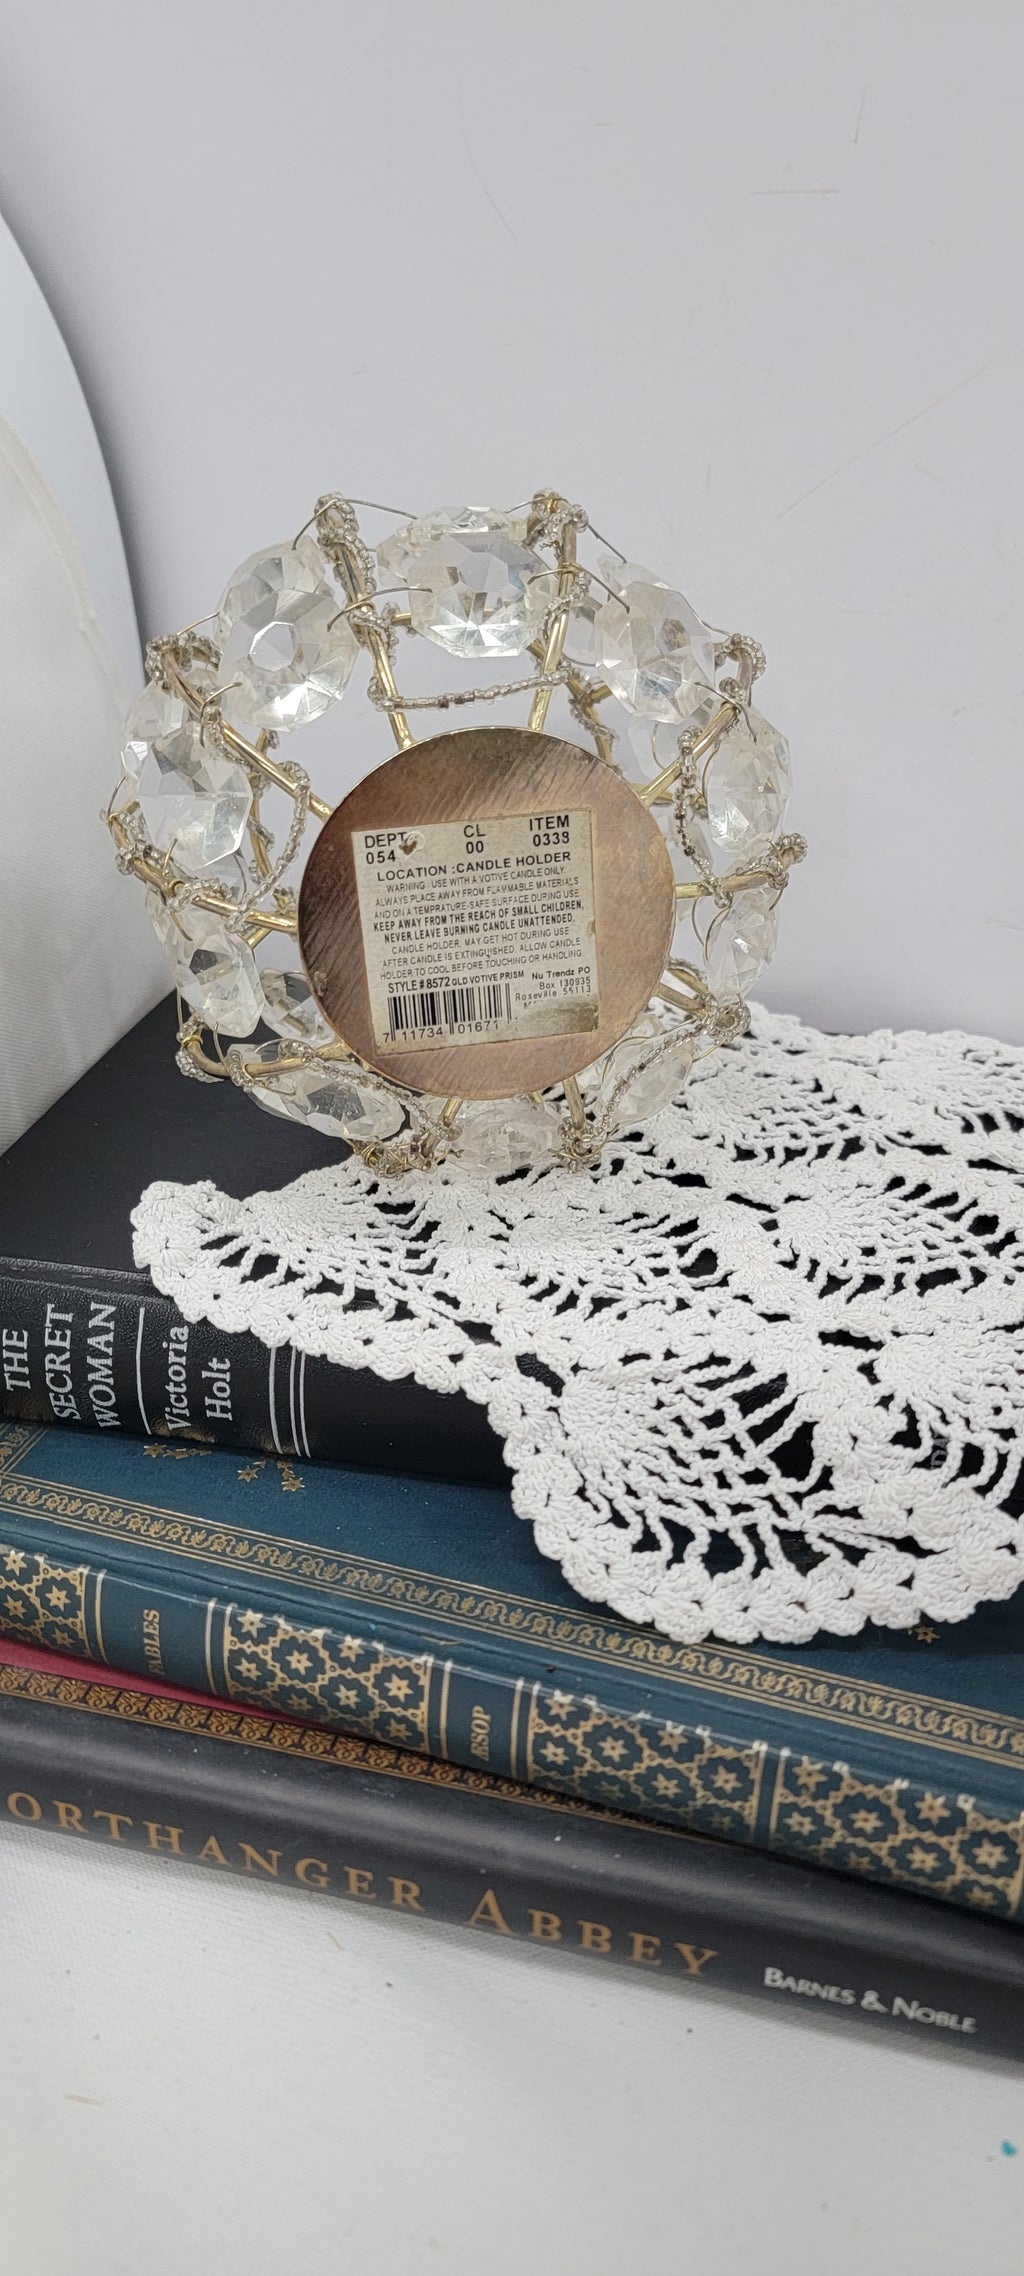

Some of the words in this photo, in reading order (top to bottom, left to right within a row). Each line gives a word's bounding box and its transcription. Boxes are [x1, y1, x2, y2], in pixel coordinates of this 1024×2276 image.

[463, 824, 486, 838] CL
[529, 815, 569, 831] ITEM
[366, 849, 396, 865] 054
[466, 841, 484, 854] 00
[377, 864, 447, 881] LOCATION
[516, 851, 571, 867] HOLDER
[375, 895, 408, 907] ALWAYS
[411, 892, 436, 903] PLACE
[438, 890, 461, 900] AWAY
[462, 887, 485, 897] FROM
[487, 881, 534, 895] FLAMMABLE
[536, 876, 579, 889] MATERIALS
[431, 879, 447, 888] USE
[449, 876, 470, 887] WITH
[472, 875, 477, 883] A
[479, 871, 508, 883] VOTIVE
[511, 868, 542, 880] CANDLE
[373, 920, 396, 932] KEEP
[399, 918, 422, 929] AWAY
[424, 915, 447, 926] FROM
[449, 913, 465, 923] THE
[468, 909, 496, 921] REACH
[498, 908, 509, 918] OF
[512, 904, 539, 917] SMALL
[374, 910, 391, 920] AND
[393, 909, 405, 918] ON
[407, 908, 412, 916] A
[492, 894, 529, 907] SURFACE
[531, 891, 562, 902] DURING
[563, 889, 580, 898] USE
[384, 931, 412, 943] NEVER
[415, 928, 441, 940] LEAVE
[443, 924, 480, 937] BURNING
[482, 920, 516, 932] CANDLE
[391, 943, 424, 955] CANDLE
[465, 937, 481, 946] MAY
[483, 935, 500, 945] GET
[501, 932, 518, 942] HOT
[520, 929, 551, 941] DURING
[553, 926, 569, 936] USE
[380, 969, 412, 980] HOLDER
[415, 967, 426, 976] TO
[427, 965, 450, 975] COOL
[451, 960, 483, 973] BEFORE
[485, 956, 527, 968] TOUCHING
[529, 954, 540, 963] OR
[542, 949, 582, 961] HANDLING
[382, 958, 408, 967] AFTER
[410, 953, 442, 965] CANDLE
[444, 952, 453, 961] IS
[519, 942, 547, 952] ALLOW
[549, 937, 581, 949] CANDLE
[388, 980, 417, 994] STYLE
[451, 977, 468, 986] GLD
[469, 972, 498, 984] VOTIVE
[500, 970, 525, 981] PRISM
[532, 972, 544, 980] Nu
[546, 968, 575, 978] Trendz
[578, 966, 591, 974] PO
[539, 981, 555, 990] Box
[515, 989, 557, 1001] Roseville
[382, 1032, 390, 1043] 7
[401, 1027, 443, 1042] 11734
[457, 1020, 498, 1035] 01671
[2, 1328, 31, 1392] THE
[44, 1303, 82, 1420] SECRET
[87, 1302, 123, 1429] WOMAN
[162, 1325, 192, 1431] Victoria
[202, 1357, 233, 1421] Holt
[465, 1888, 718, 1976] ABBEY
[764, 1966, 857, 2005] BARNES
[860, 1990, 888, 2014] &
[891, 1996, 978, 2034] NOBLE
